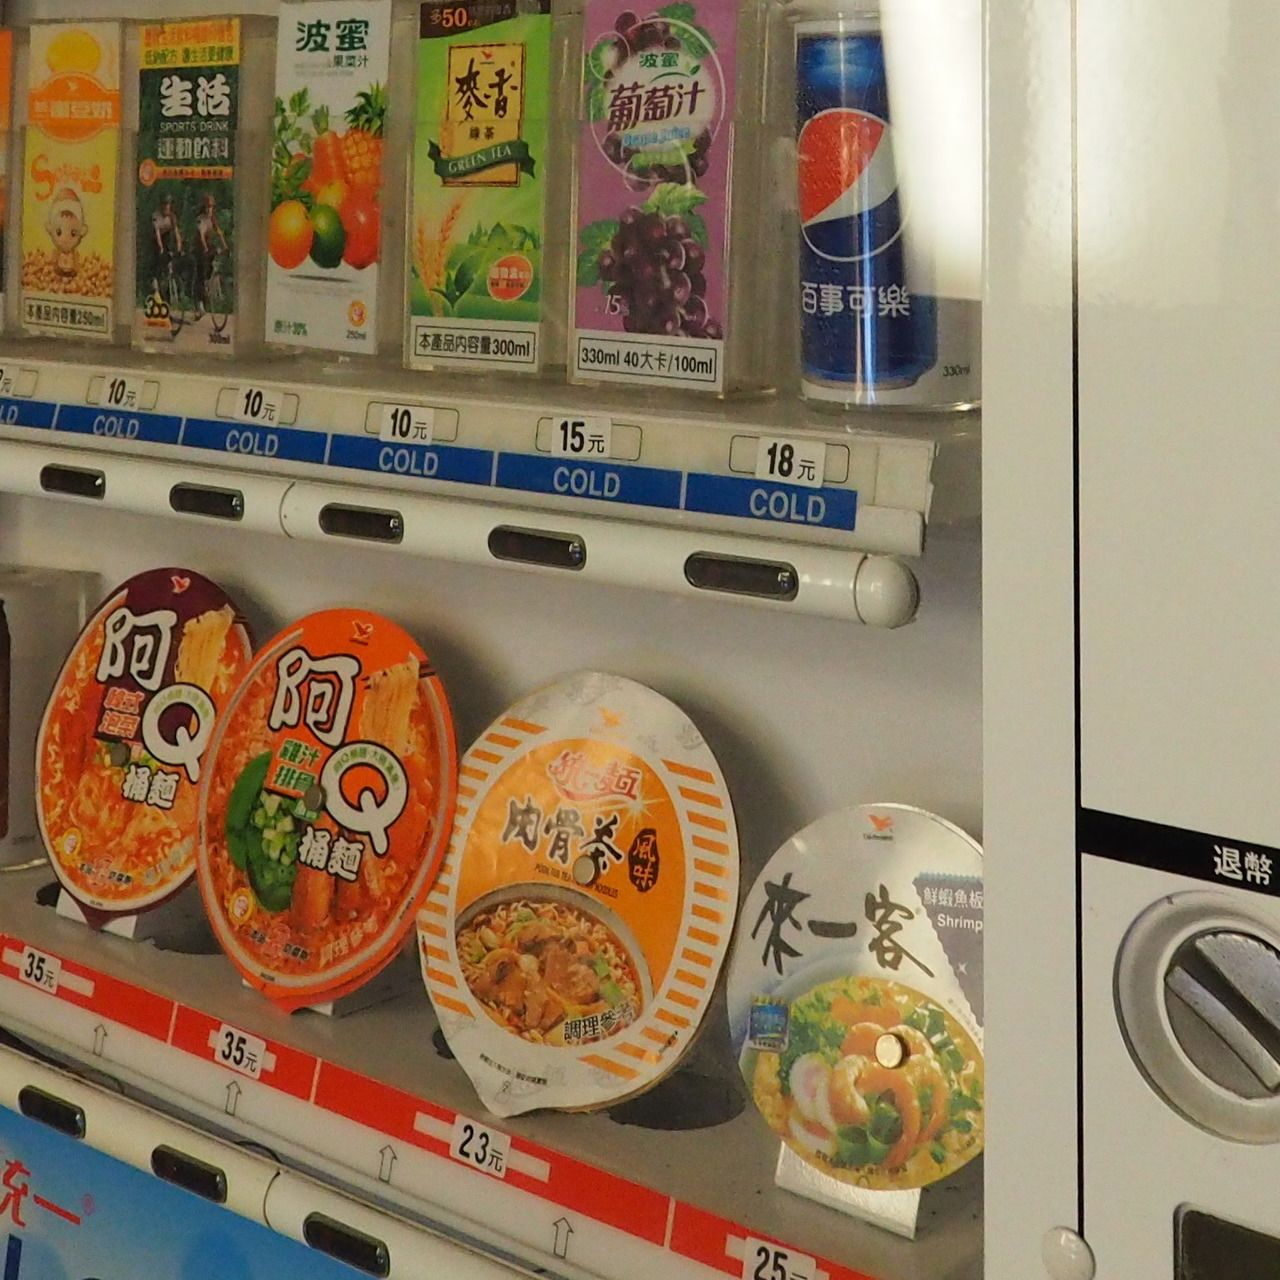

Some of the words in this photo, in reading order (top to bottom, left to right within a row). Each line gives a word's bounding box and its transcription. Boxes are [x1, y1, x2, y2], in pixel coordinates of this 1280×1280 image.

[295, 18, 370, 52] 波蜜
[638, 52, 680, 69] 波蜜
[160, 73, 231, 117] 生活
[455, 58, 519, 124] 麥香
[607, 81, 706, 133] 葡萄汁
[160, 122, 197, 132] SPORTS
[200, 121, 229, 131] DRINK
[468, 127, 495, 140] 綠茶
[158, 137, 229, 159] 運動飲料
[448, 153, 486, 173] GREEN
[490, 144, 512, 160] TEA
[801, 281, 910, 319] 百事可樂
[581, 346, 621, 366] 330ml
[623, 349, 714, 375] 40大卡/100ml
[108, 377, 136, 408] 10元
[243, 389, 275, 420] 10元
[93, 415, 139, 439] COLD
[390, 409, 428, 440] 10元
[560, 421, 605, 453] 15元
[225, 430, 278, 457] COLD
[379, 447, 439, 476] COLD
[767, 442, 816, 482] 18元
[553, 467, 621, 498] COLD
[750, 489, 826, 524] COLD
[122, 763, 180, 810] 桶麵
[502, 795, 623, 872] 肉骨茶
[298, 824, 366, 883] 桶麵
[632, 833, 657, 890] 風味
[1213, 846, 1273, 886] 退幣
[751, 872, 935, 978] 來一客
[937, 912, 984, 933] Shrimp
[23, 950, 55, 990] 35元
[220, 1029, 257, 1072] 35元
[458, 1124, 502, 1173] 23元
